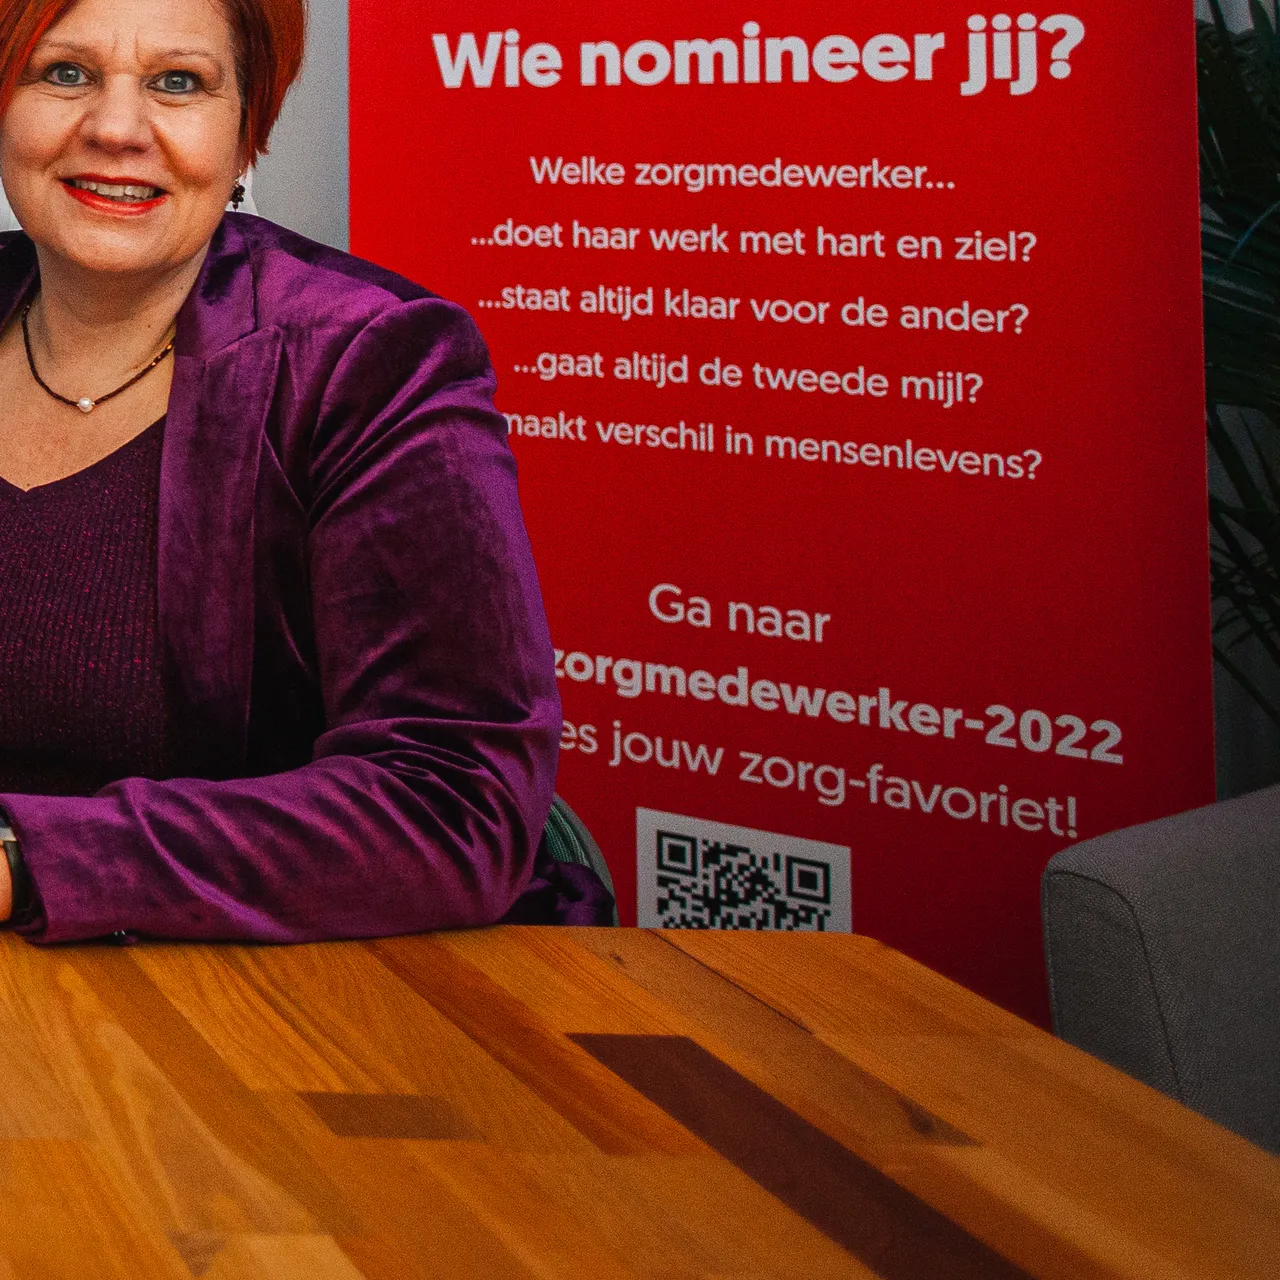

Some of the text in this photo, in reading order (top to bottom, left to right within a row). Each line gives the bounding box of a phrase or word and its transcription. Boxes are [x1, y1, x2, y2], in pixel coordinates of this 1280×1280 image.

[431, 12, 1086, 96] Wie nomineer jij?
[529, 156, 955, 193] Welke zorgmedewerker...
[471, 218, 1037, 262] ...doet haar werk met hart en ziel?
[478, 285, 1029, 335] ...staat altijd klaar voor de ander?
[513, 351, 983, 409] ...gaat altijd de tweede mijl?
[595, 421, 714, 452] verschil
[725, 425, 753, 455] in
[764, 435, 1042, 480] mensenlevens?
[648, 583, 831, 643] Ga naar
[608, 719, 724, 775] jouw
[739, 751, 1078, 839] zorg-favoriet!
